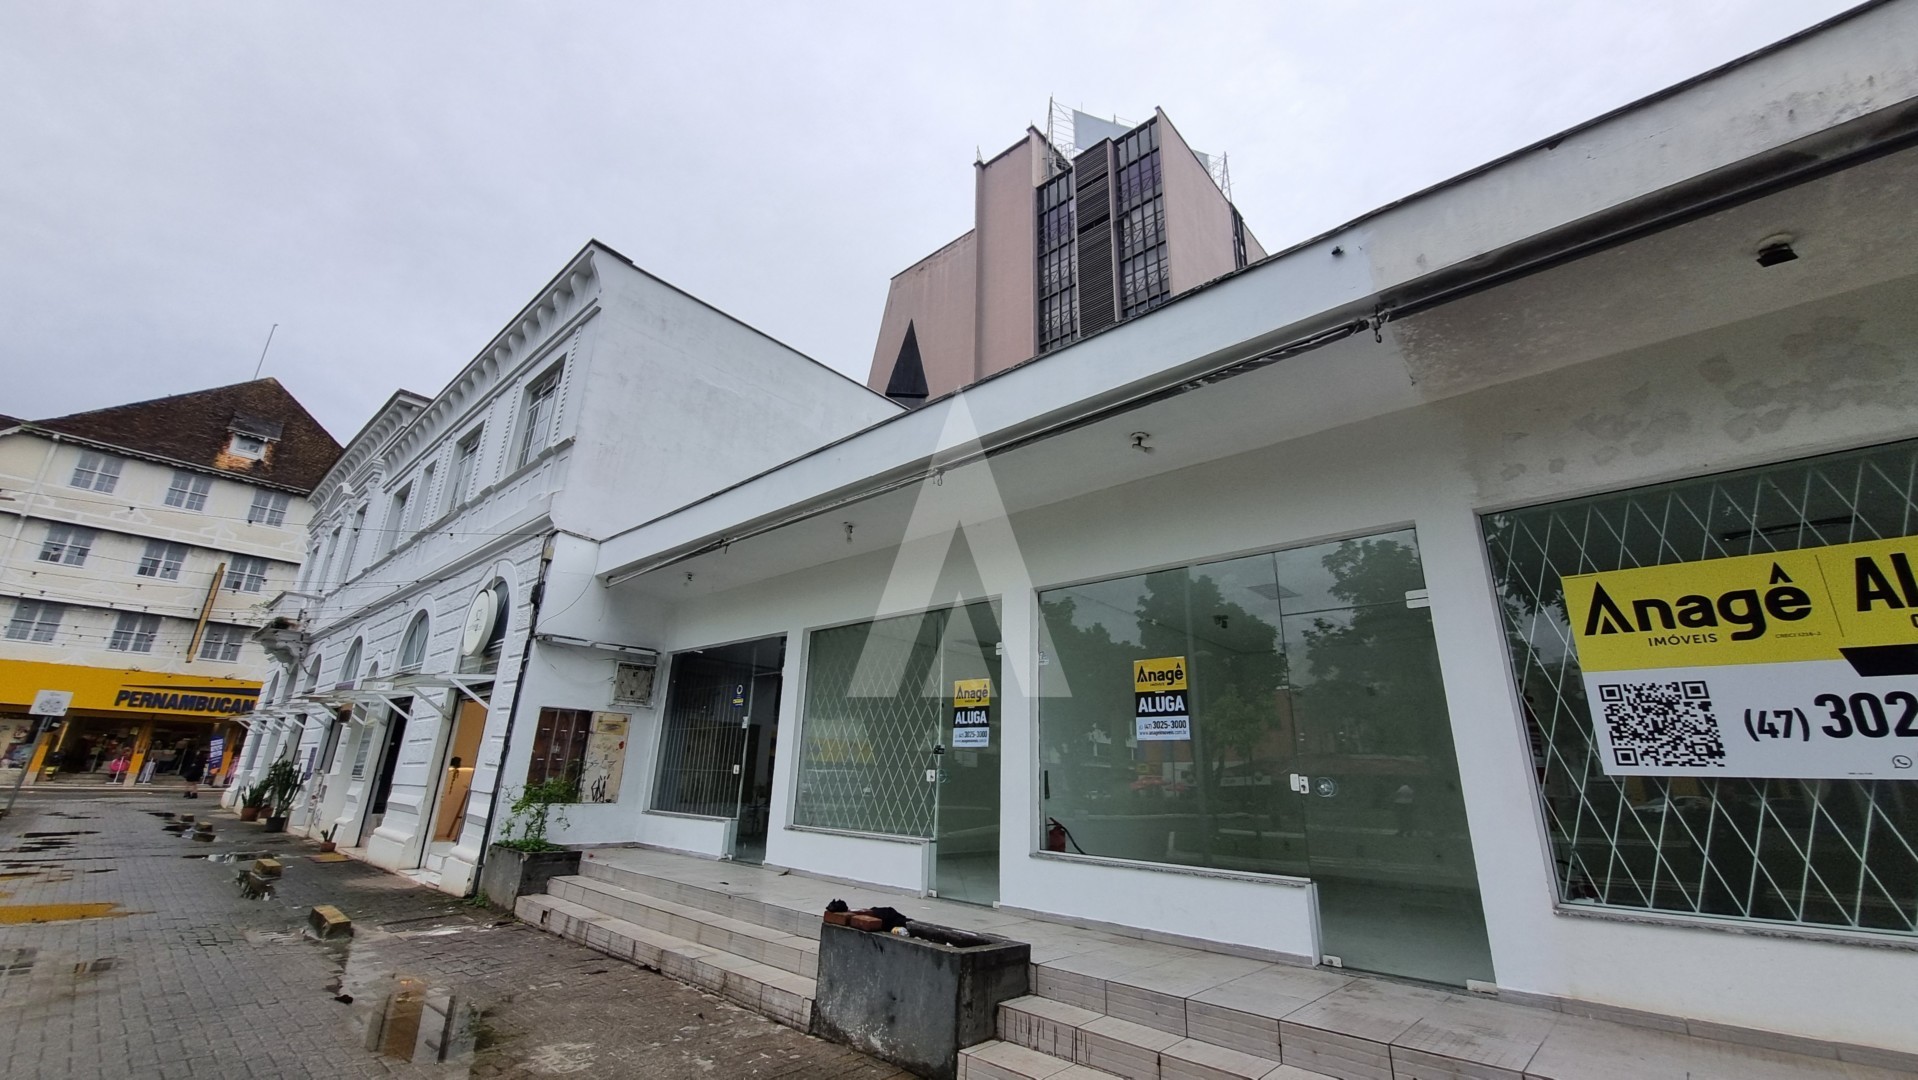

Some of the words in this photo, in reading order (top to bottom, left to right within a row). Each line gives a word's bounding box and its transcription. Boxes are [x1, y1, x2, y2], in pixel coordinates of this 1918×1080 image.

[1648, 633, 1718, 647] IMÓVEIS
[1137, 662, 1184, 685] Anagê
[1138, 695, 1185, 713] ALUGA
[955, 710, 987, 724] ALUGA
[1744, 707, 1811, 742] (47)
[1814, 690, 1918, 739] 302
[1153, 720, 1187, 729] 3025-3000
